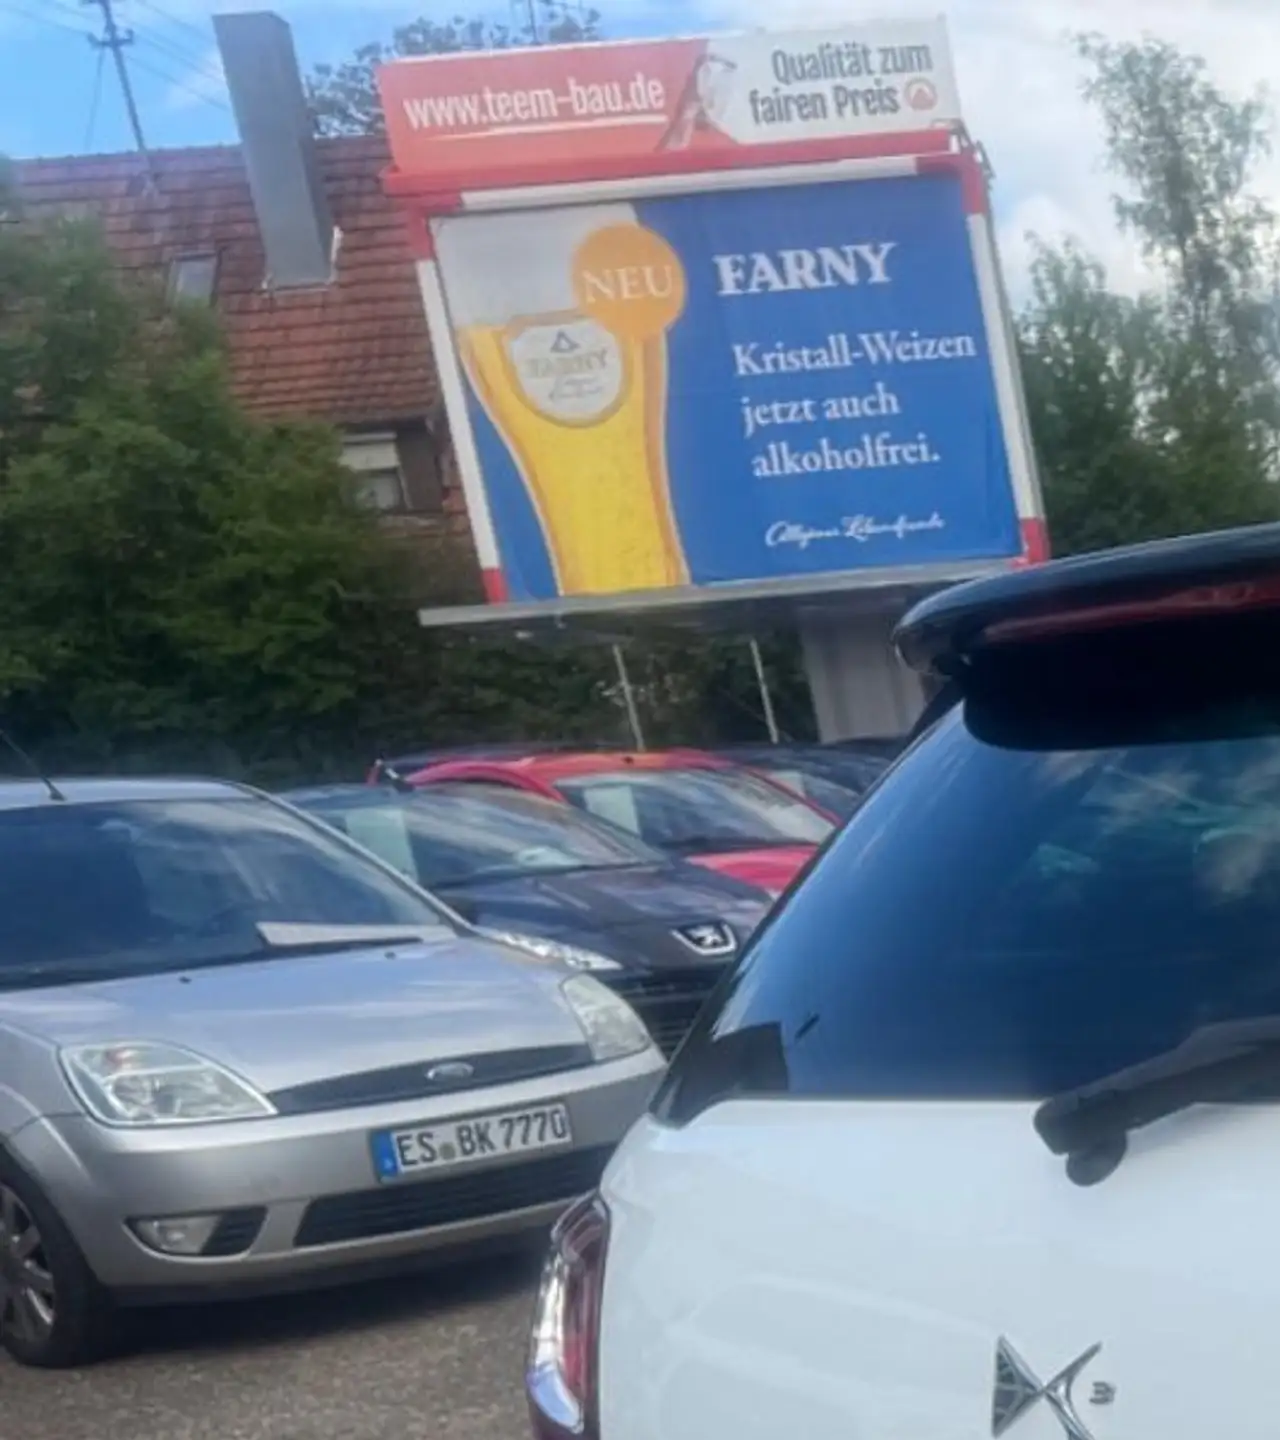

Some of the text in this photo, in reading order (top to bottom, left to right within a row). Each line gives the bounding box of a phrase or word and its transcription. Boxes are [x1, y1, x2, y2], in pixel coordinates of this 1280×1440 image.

[772, 43, 933, 85] Qualität zum
[404, 72, 665, 130] www.teem-bau.de
[749, 80, 901, 127] fairen Preis
[581, 265, 673, 304] NEU
[711, 242, 897, 295] FARNY
[732, 329, 976, 376] Kristall-Weizen
[741, 381, 900, 439] jetzt auch
[752, 432, 940, 477] alkoholfrei.
[396, 1108, 568, 1167] ES BK 7770
